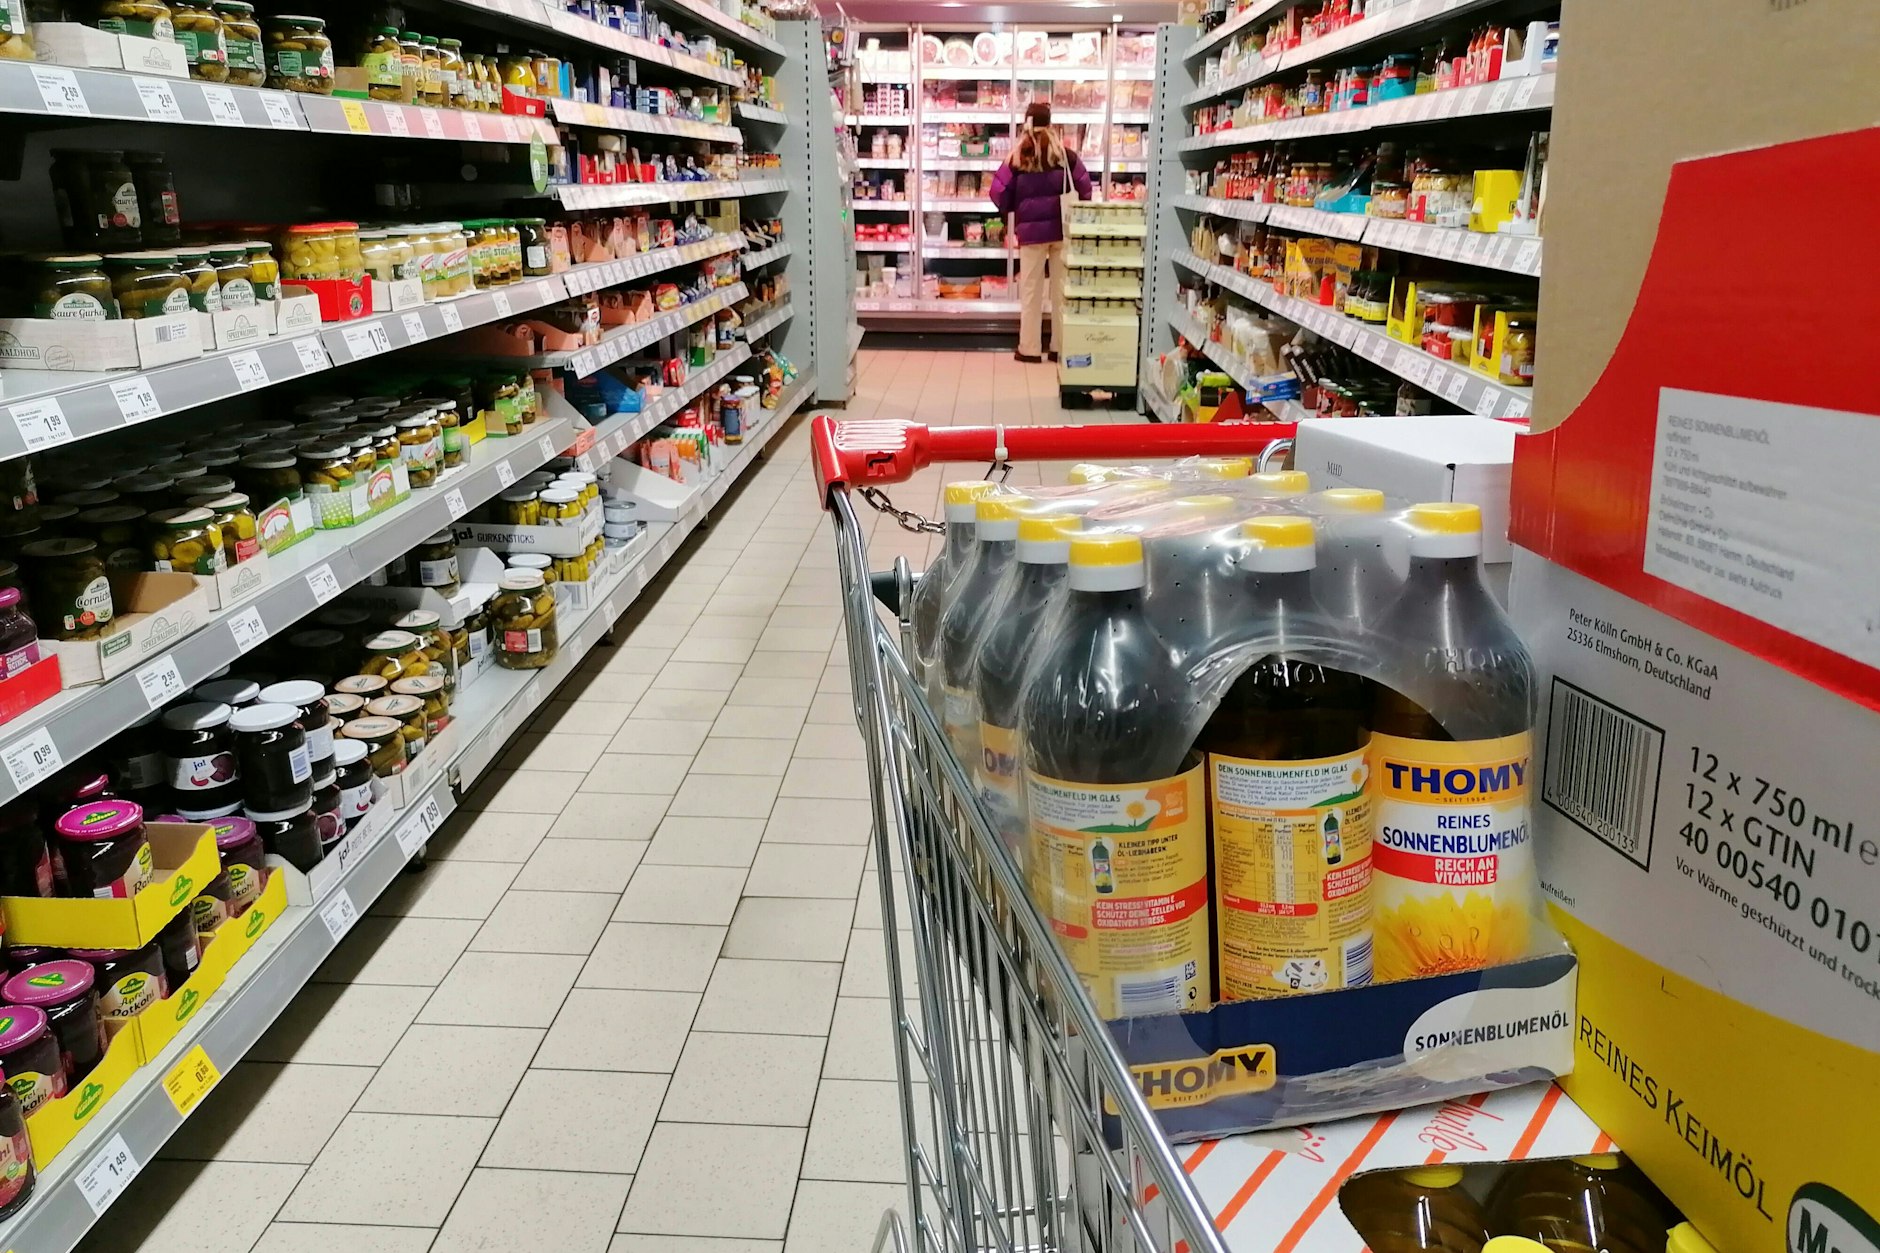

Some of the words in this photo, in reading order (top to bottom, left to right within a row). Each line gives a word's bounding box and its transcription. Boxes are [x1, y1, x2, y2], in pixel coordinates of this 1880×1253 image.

[51, 308, 78, 318] Saure
[1327, 461, 1343, 477] MHD
[452, 527, 474, 545] ja!
[477, 532, 535, 545] GURKENSTICKS
[1569, 607, 1592, 628] Peter
[1594, 617, 1618, 639] Kölln
[1620, 629, 1652, 653] GmbH
[1655, 642, 1663, 657] &
[1666, 647, 1683, 667] Co.
[1687, 655, 1719, 681] KGaA
[1567, 627, 1594, 650] 25336
[1595, 639, 1641, 673] Elmshorn,
[1644, 660, 1712, 701] Deutschland
[33, 744, 52, 765] 0,99
[193, 760, 206, 772] ja!
[1218, 764, 1234, 773] DEIN
[1235, 765, 1320, 779] SONNENBLUMENFELD
[1321, 767, 1330, 775] IM
[1331, 764, 1348, 775] GLAS
[1385, 757, 1529, 796] THOMY
[1088, 794, 1097, 802] IM
[1100, 794, 1121, 803] GLAS
[1691, 746, 1718, 783] 12
[1727, 772, 1740, 795] x
[1752, 777, 1805, 827] 750
[1812, 815, 1853, 853] ml
[419, 801, 439, 833] 1,89
[1437, 814, 1491, 829] REINES
[1558, 793, 1593, 826] 000540
[1596, 813, 1635, 855] 200133
[1160, 834, 1178, 844] UNTER
[1382, 820, 1529, 854] SONNENBLUMENÖL
[1686, 783, 1714, 820] 12
[1720, 808, 1735, 832] x
[1743, 816, 1815, 878] GTIN
[1435, 858, 1476, 872] REICH
[1477, 857, 1494, 871] AN
[1680, 822, 1709, 855] 40
[1716, 841, 1801, 911] 00540
[1435, 870, 1484, 884] VITAMIN
[1487, 869, 1495, 883] E
[1096, 902, 1114, 910] KEIN
[1144, 896, 1170, 907] VITAMIN
[1097, 910, 1127, 919] SCHÜTZT
[1128, 909, 1150, 918] DEINE
[1151, 904, 1175, 915] ZELLEN
[1175, 900, 1186, 910] VOR
[1097, 918, 1139, 927] OXIDATIVEM
[1676, 856, 1696, 875] Vor
[1697, 872, 1739, 908] Wärme
[1740, 902, 1806, 952] geschützt
[1808, 944, 1839, 973] und
[1415, 1010, 1570, 1052] SONNENBLUMENÖL
[1580, 1015, 1658, 1110] REINES
[1664, 1088, 1774, 1223] KEIMÖL
[108, 1151, 127, 1177] 1,49
